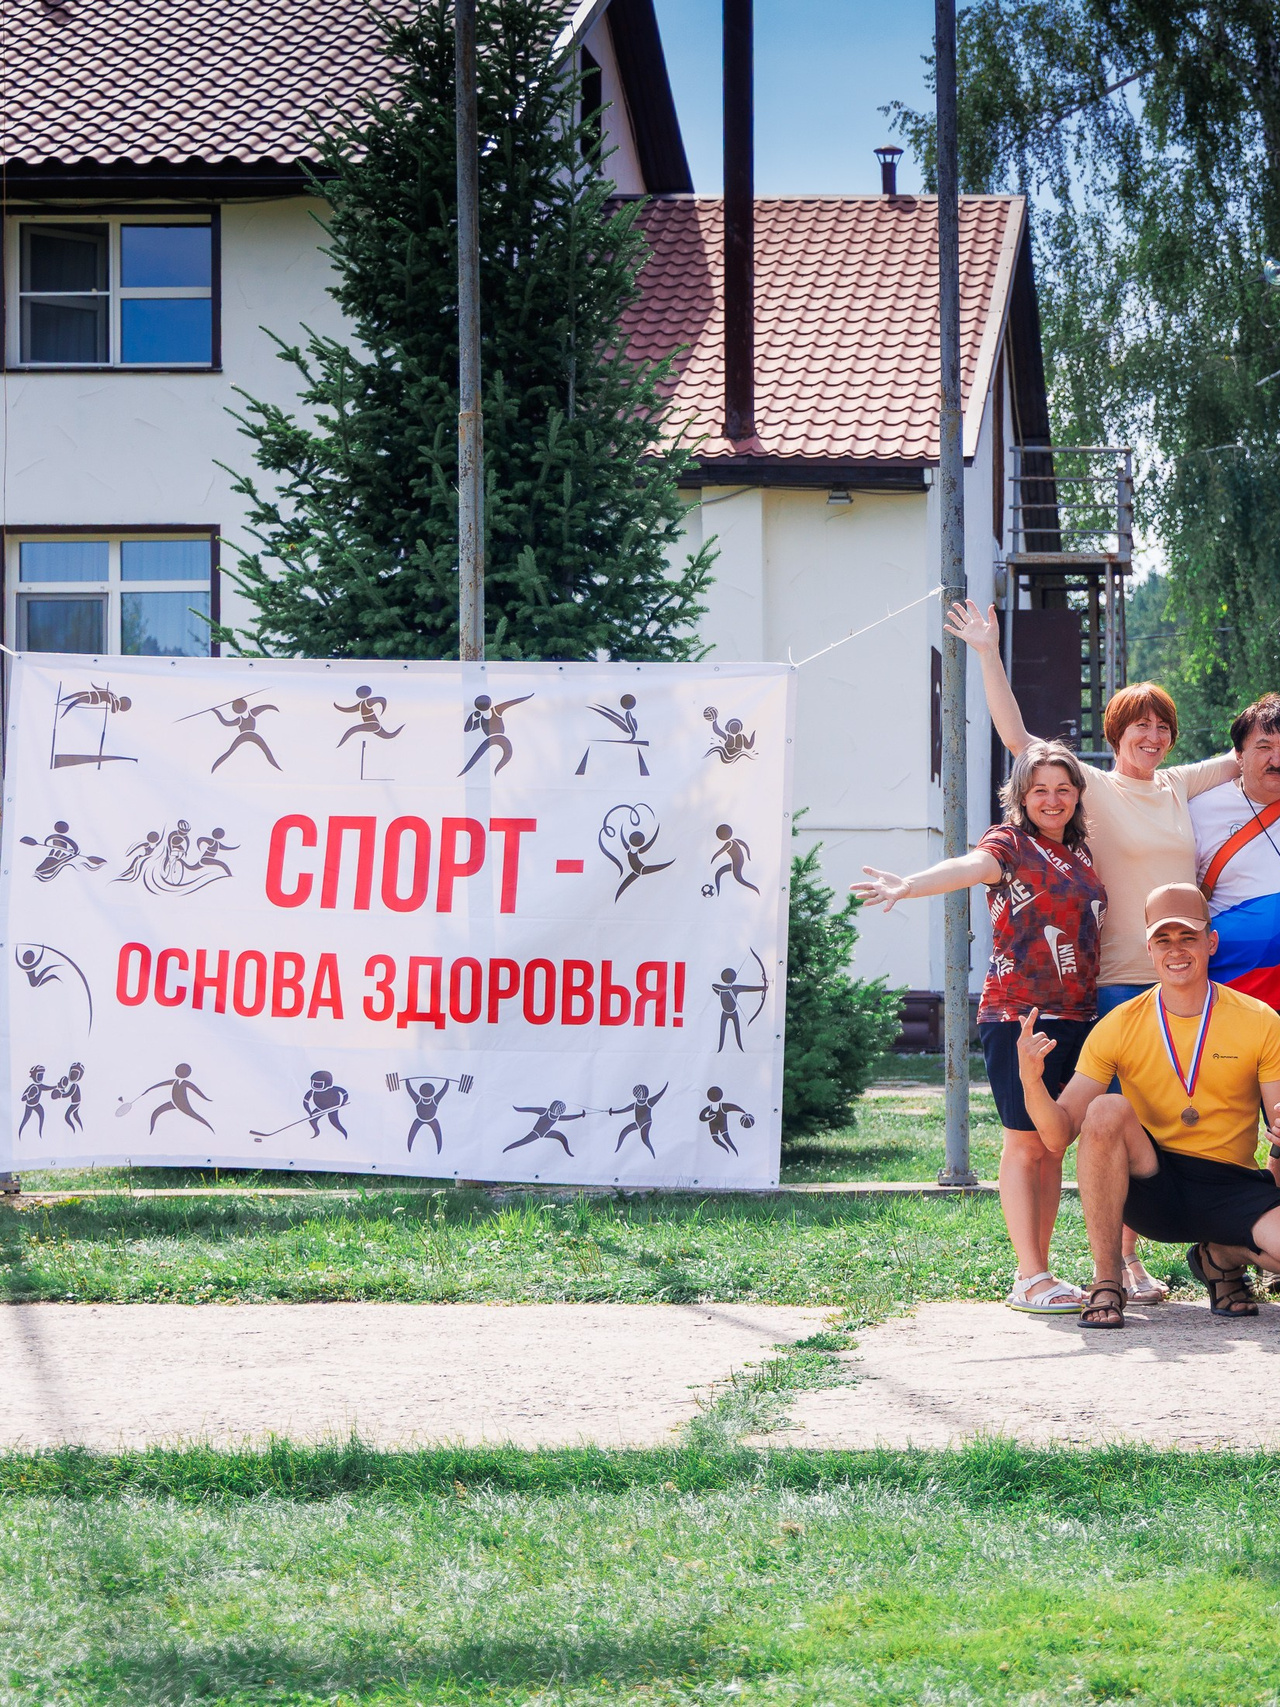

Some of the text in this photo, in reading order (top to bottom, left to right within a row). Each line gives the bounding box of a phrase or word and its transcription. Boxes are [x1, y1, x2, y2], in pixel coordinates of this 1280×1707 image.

[265, 813, 585, 914] СПОРТ -
[115, 942, 687, 1031] ОСНОВА ЗДОРОВЬЯ!
[1057, 943, 1077, 975] NIKE
